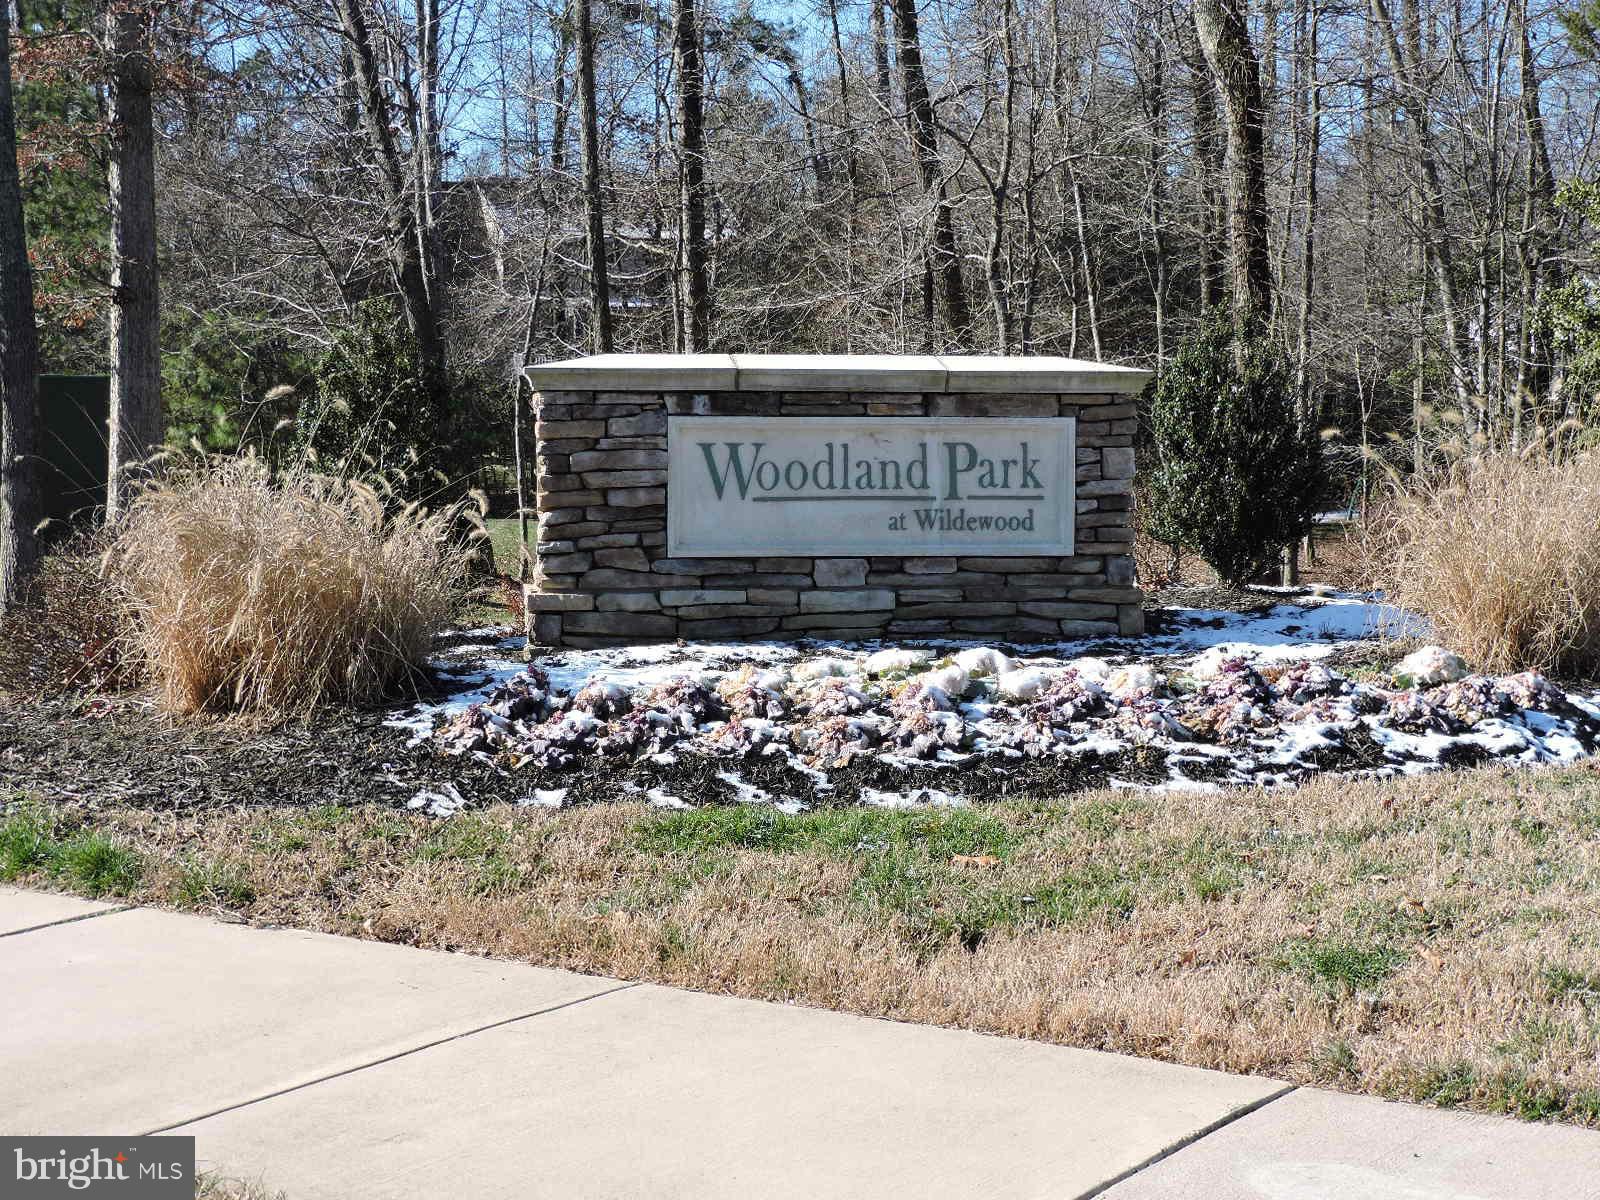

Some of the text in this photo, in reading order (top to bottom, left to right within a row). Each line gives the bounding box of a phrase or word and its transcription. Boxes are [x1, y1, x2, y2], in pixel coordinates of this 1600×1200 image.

[696, 441, 1044, 501] Woodland Park
[888, 508, 1034, 532] at Wildewood
